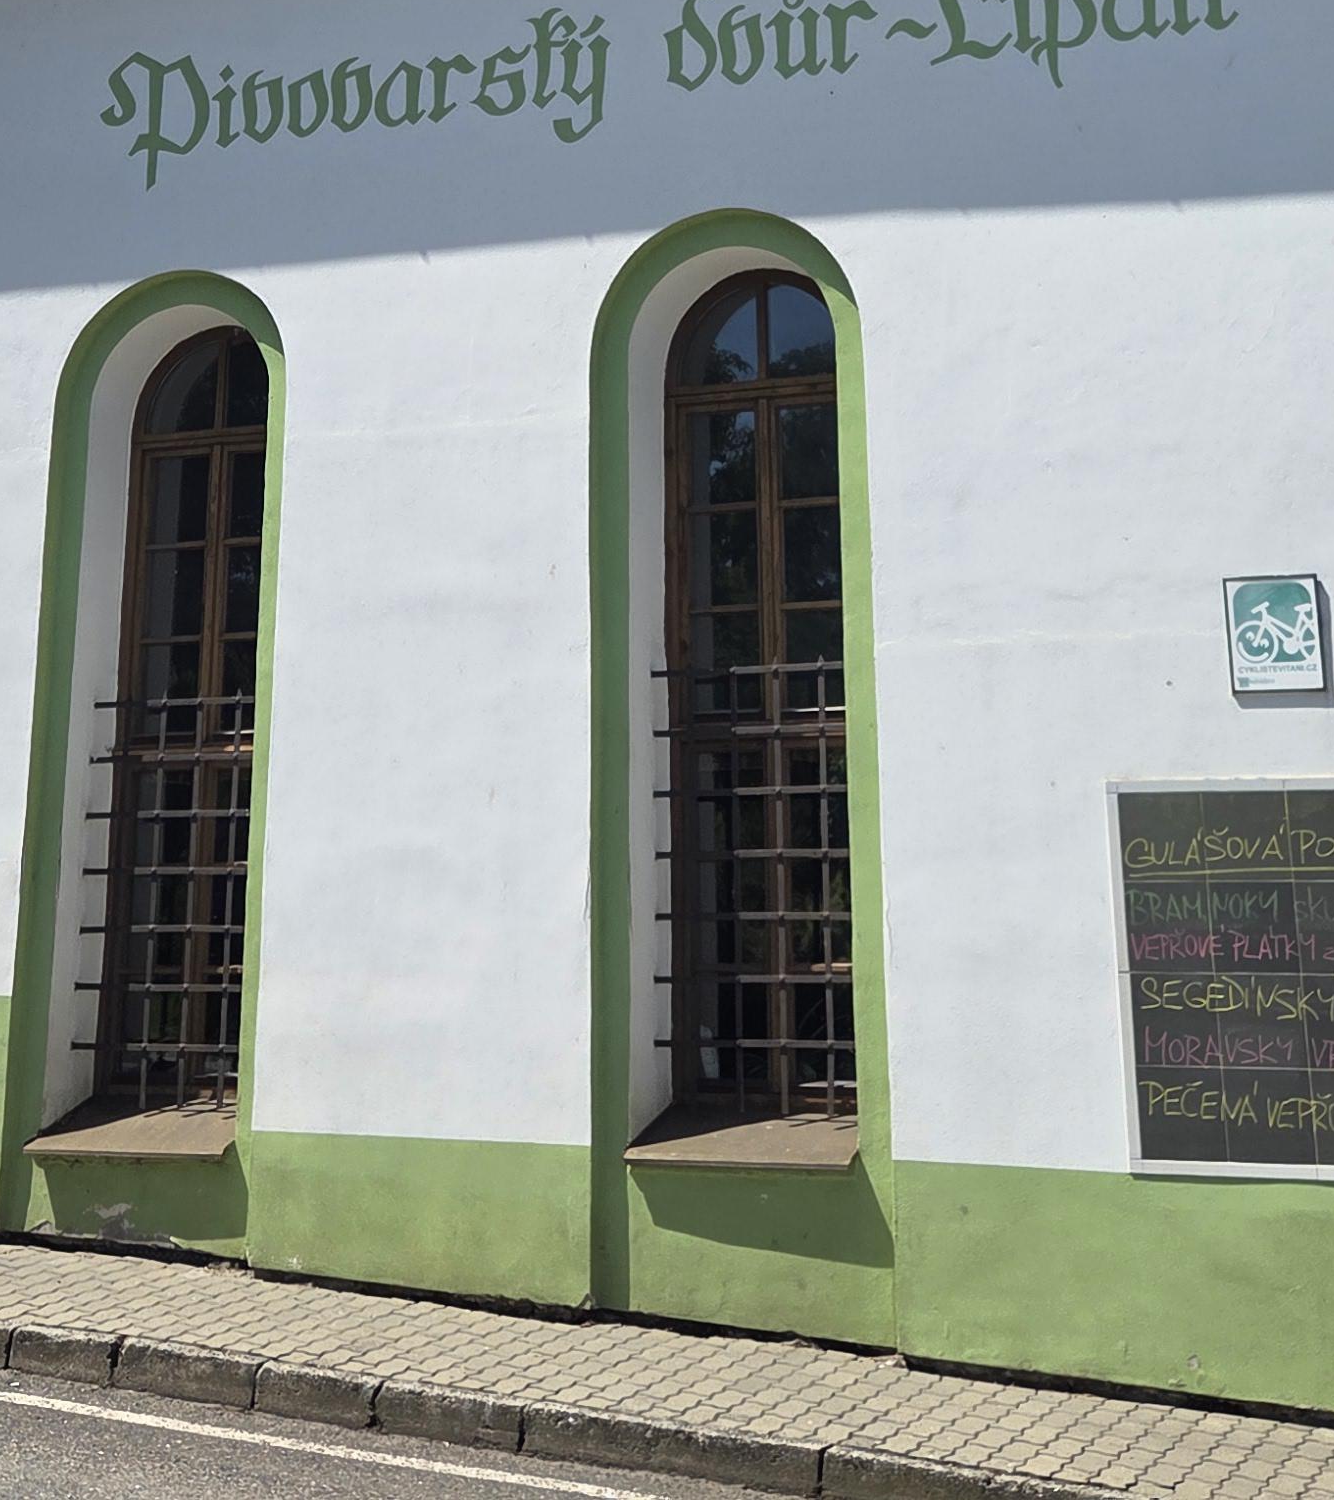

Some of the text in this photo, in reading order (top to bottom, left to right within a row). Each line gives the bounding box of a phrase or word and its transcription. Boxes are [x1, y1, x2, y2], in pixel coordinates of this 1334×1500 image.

[100, 7, 611, 192] Pivovarský
[1124, 824, 1285, 868] GULÁŠOVÁ
[1139, 1080, 1259, 1126] PEČENÁ
